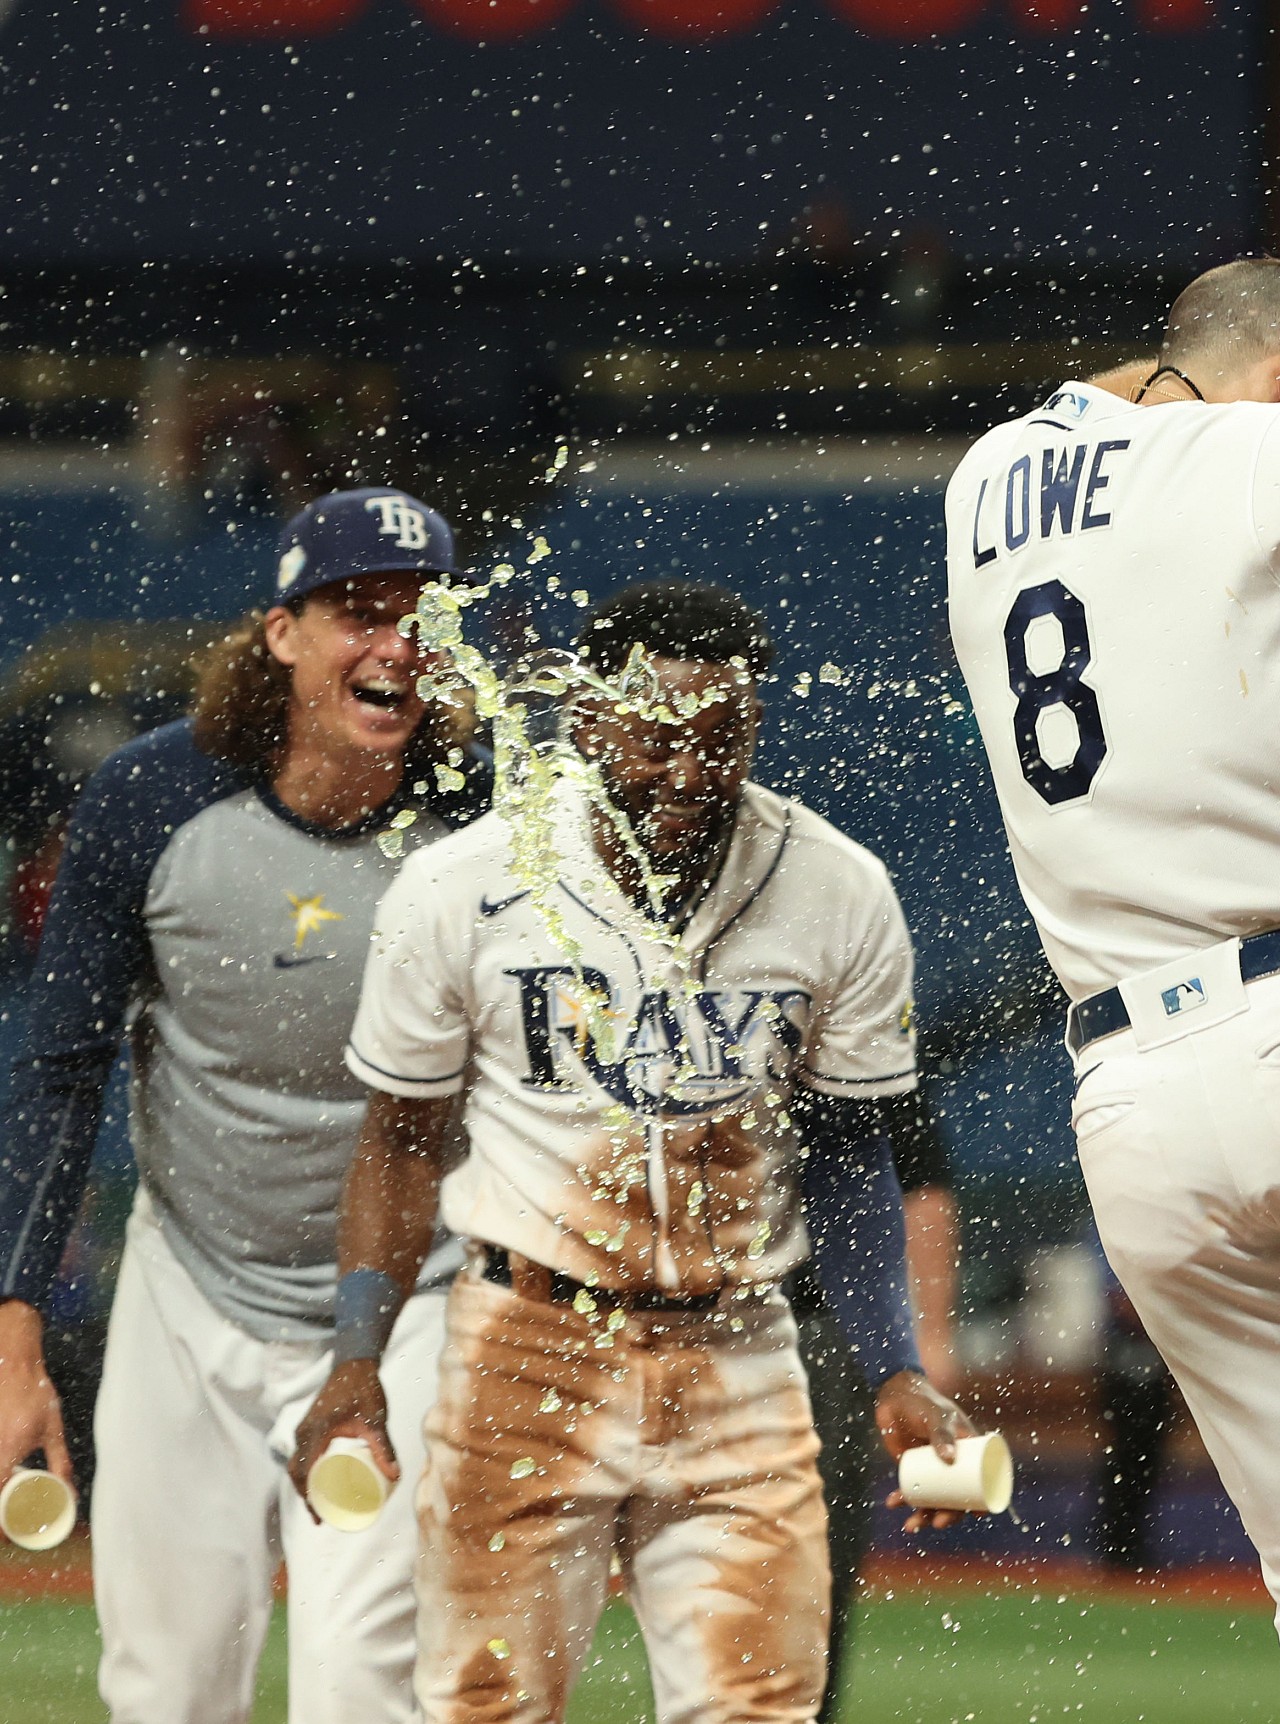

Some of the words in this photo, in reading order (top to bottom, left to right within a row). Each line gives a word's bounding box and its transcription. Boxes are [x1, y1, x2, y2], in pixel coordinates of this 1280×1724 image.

[364, 496, 428, 550] TB
[972, 439, 1132, 570] LOWE
[1002, 577, 1108, 807] 8
